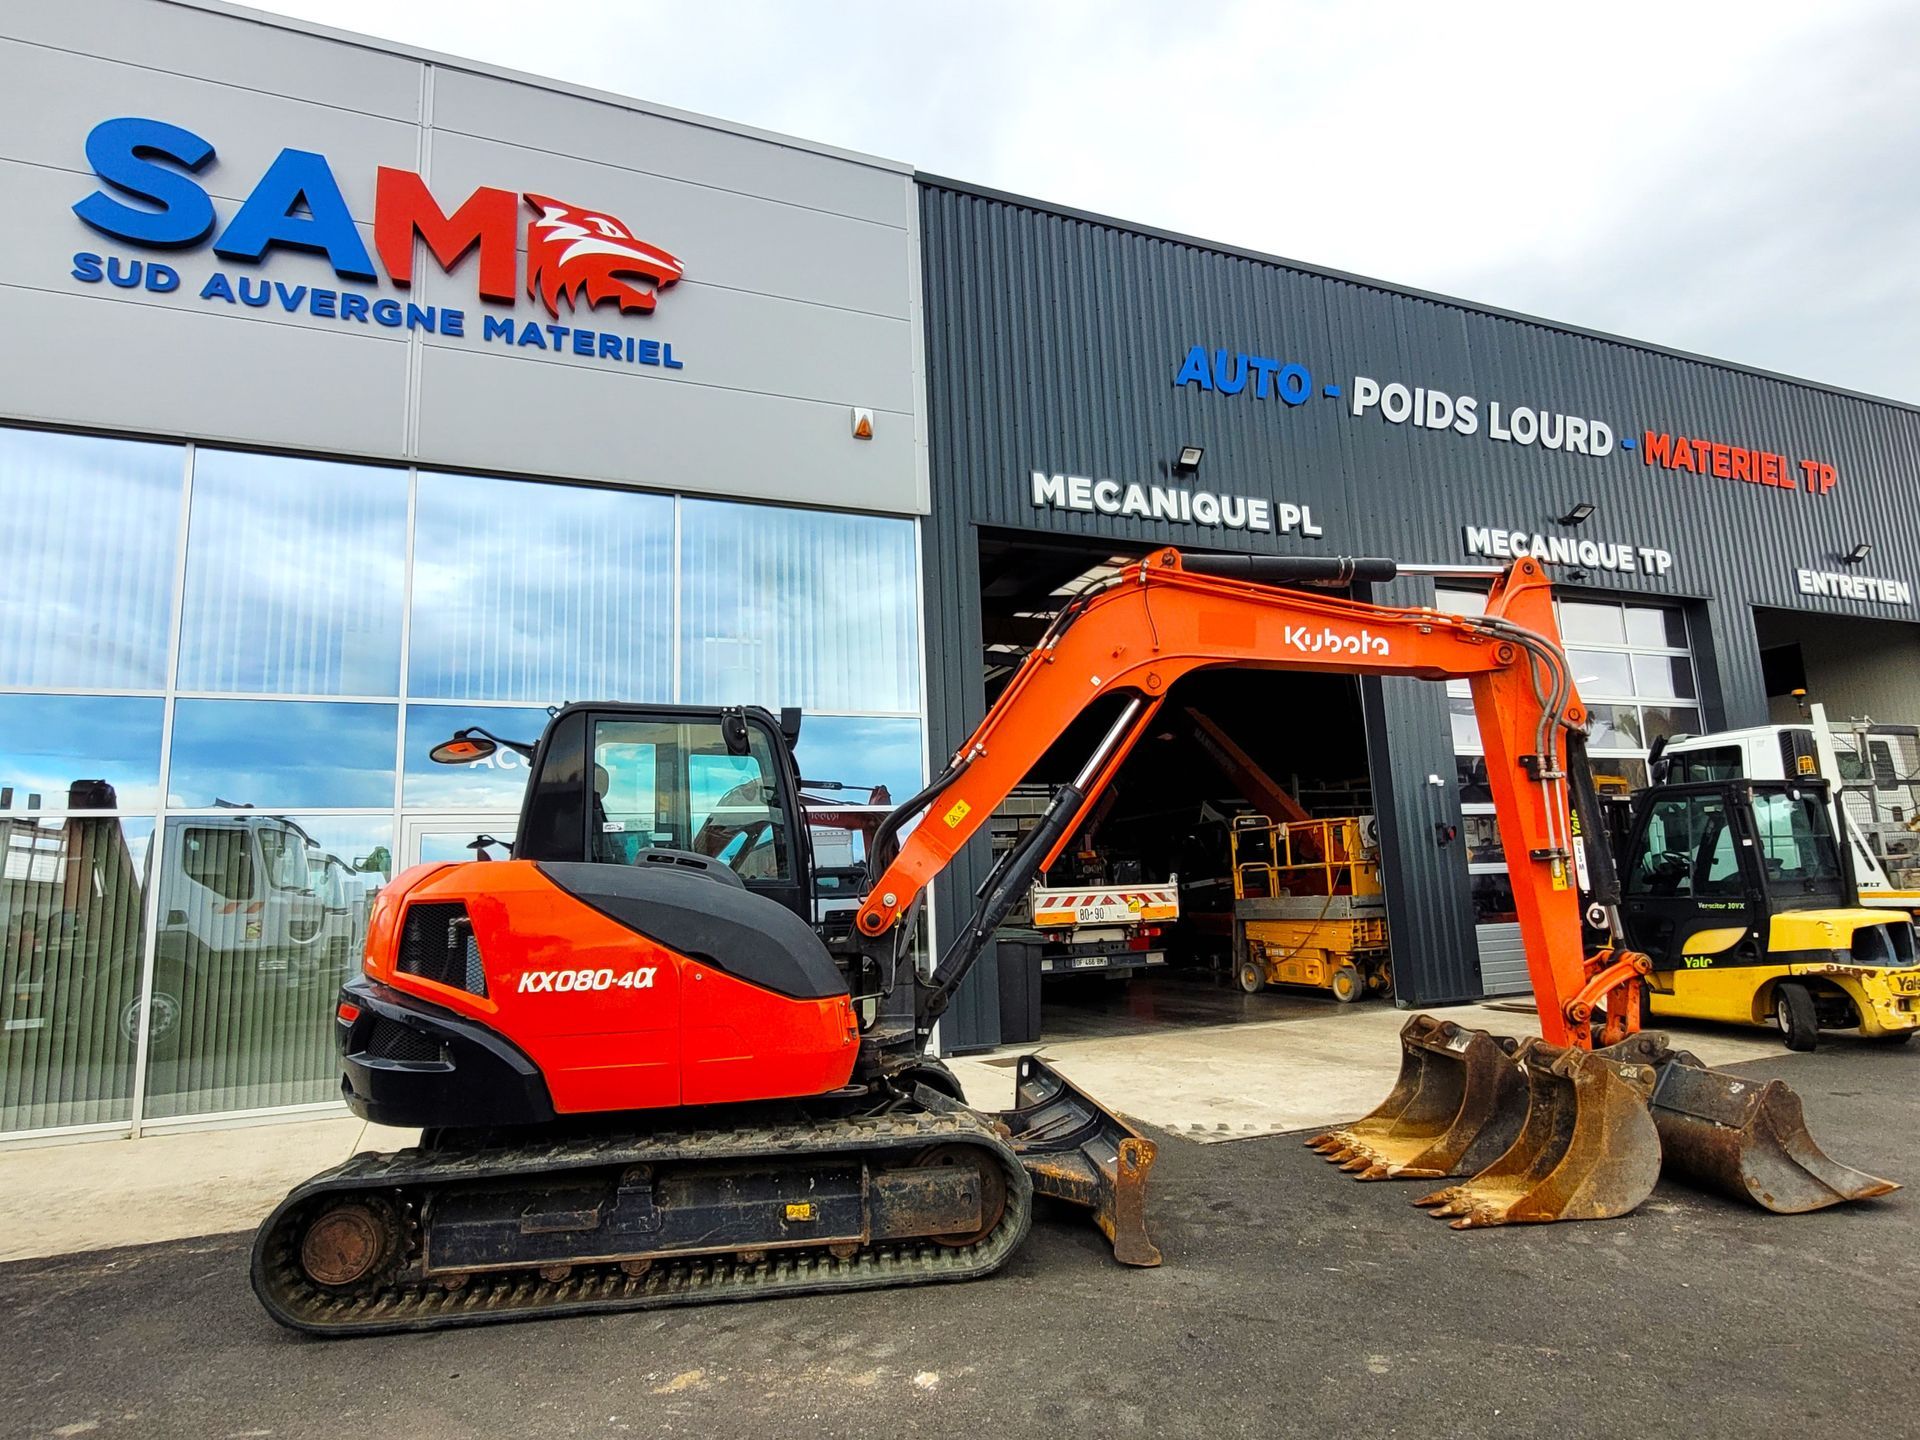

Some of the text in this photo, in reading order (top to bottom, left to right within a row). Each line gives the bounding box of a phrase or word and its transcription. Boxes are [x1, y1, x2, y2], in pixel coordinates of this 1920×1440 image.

[72, 117, 519, 307] SAM
[71, 252, 684, 369] SUD AUVERGNE MATERIEL
[1175, 346, 1312, 406] AUTO
[1352, 376, 1479, 435] POIDS
[1488, 401, 1614, 457] LOURD
[1644, 430, 1796, 490] MATERIEL
[1801, 459, 1838, 495] TP
[1031, 471, 1323, 536] MECANIQUE PL
[1465, 525, 1673, 575] MECANIQUE TP
[1796, 568, 1912, 606] ENTRETIEN
[1284, 625, 1390, 656] Kubota
